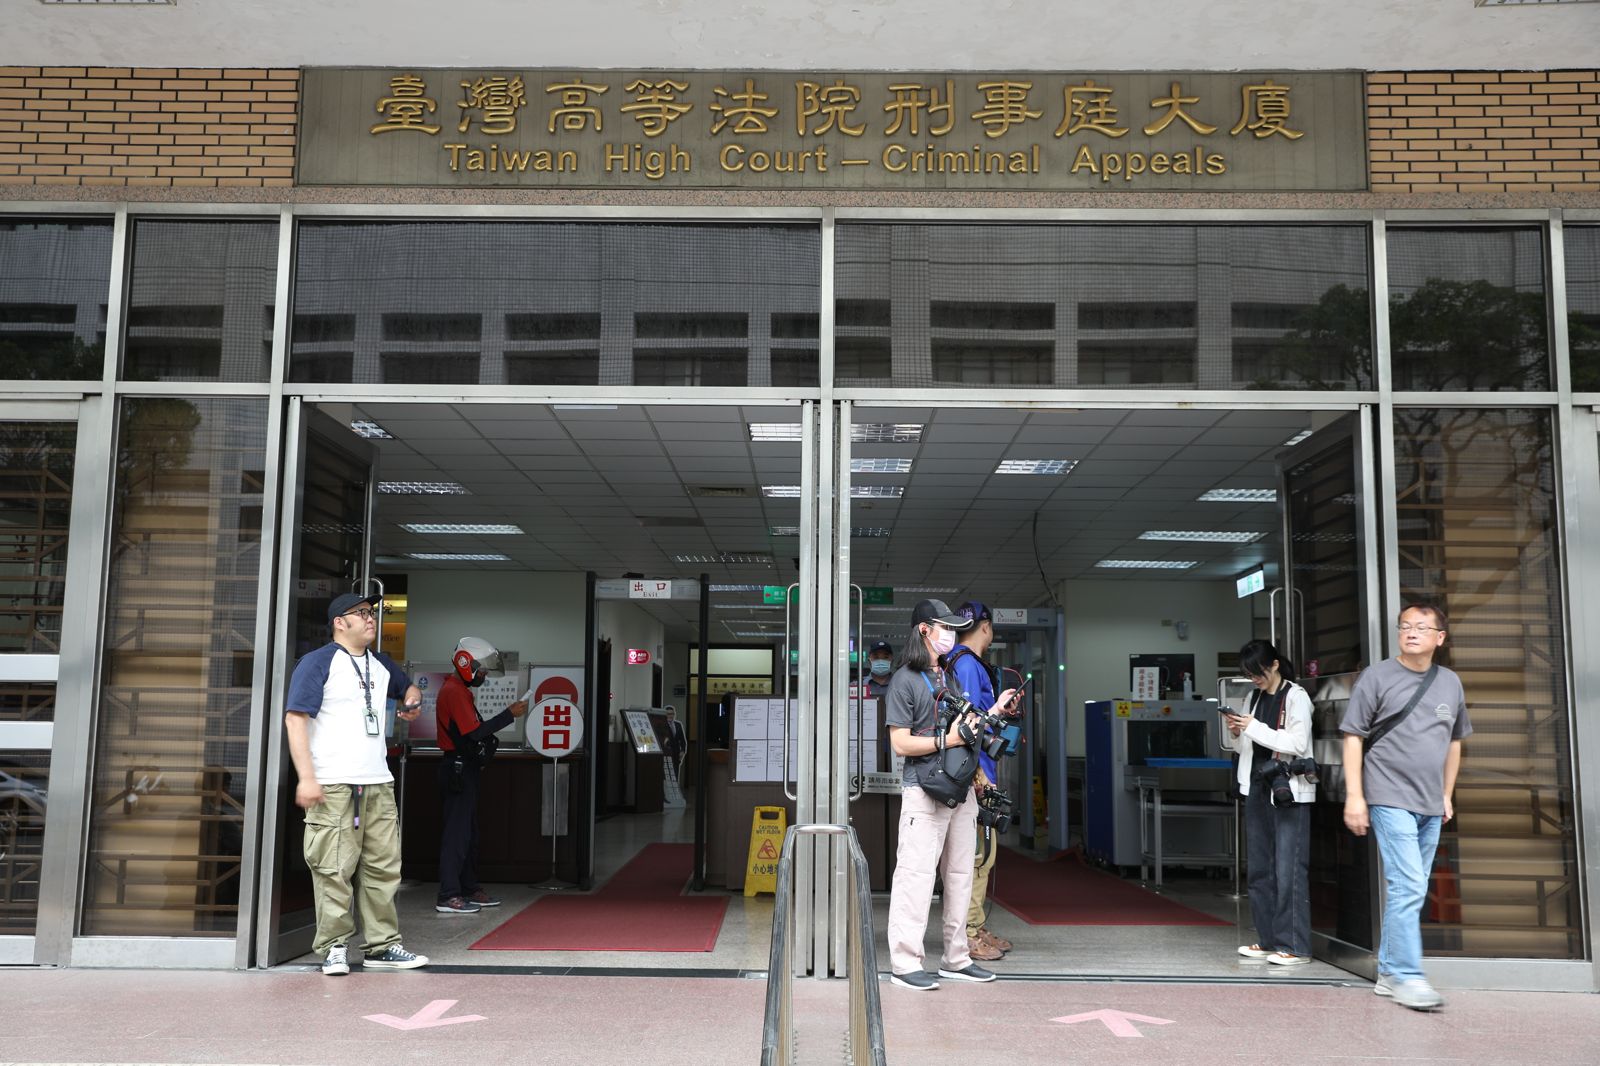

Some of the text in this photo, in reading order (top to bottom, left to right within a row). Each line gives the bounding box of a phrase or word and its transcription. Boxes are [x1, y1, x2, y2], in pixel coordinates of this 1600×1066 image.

[370, 73, 1304, 140] 臺灣高等法院刑事庭大廈
[443, 142, 578, 173] Taiwan
[604, 143, 692, 180] High
[719, 144, 828, 173] Court
[882, 143, 1040, 173] Criminal
[1071, 144, 1227, 182] Appeals
[634, 581, 667, 592] 出口
[542, 704, 571, 750] 出口
